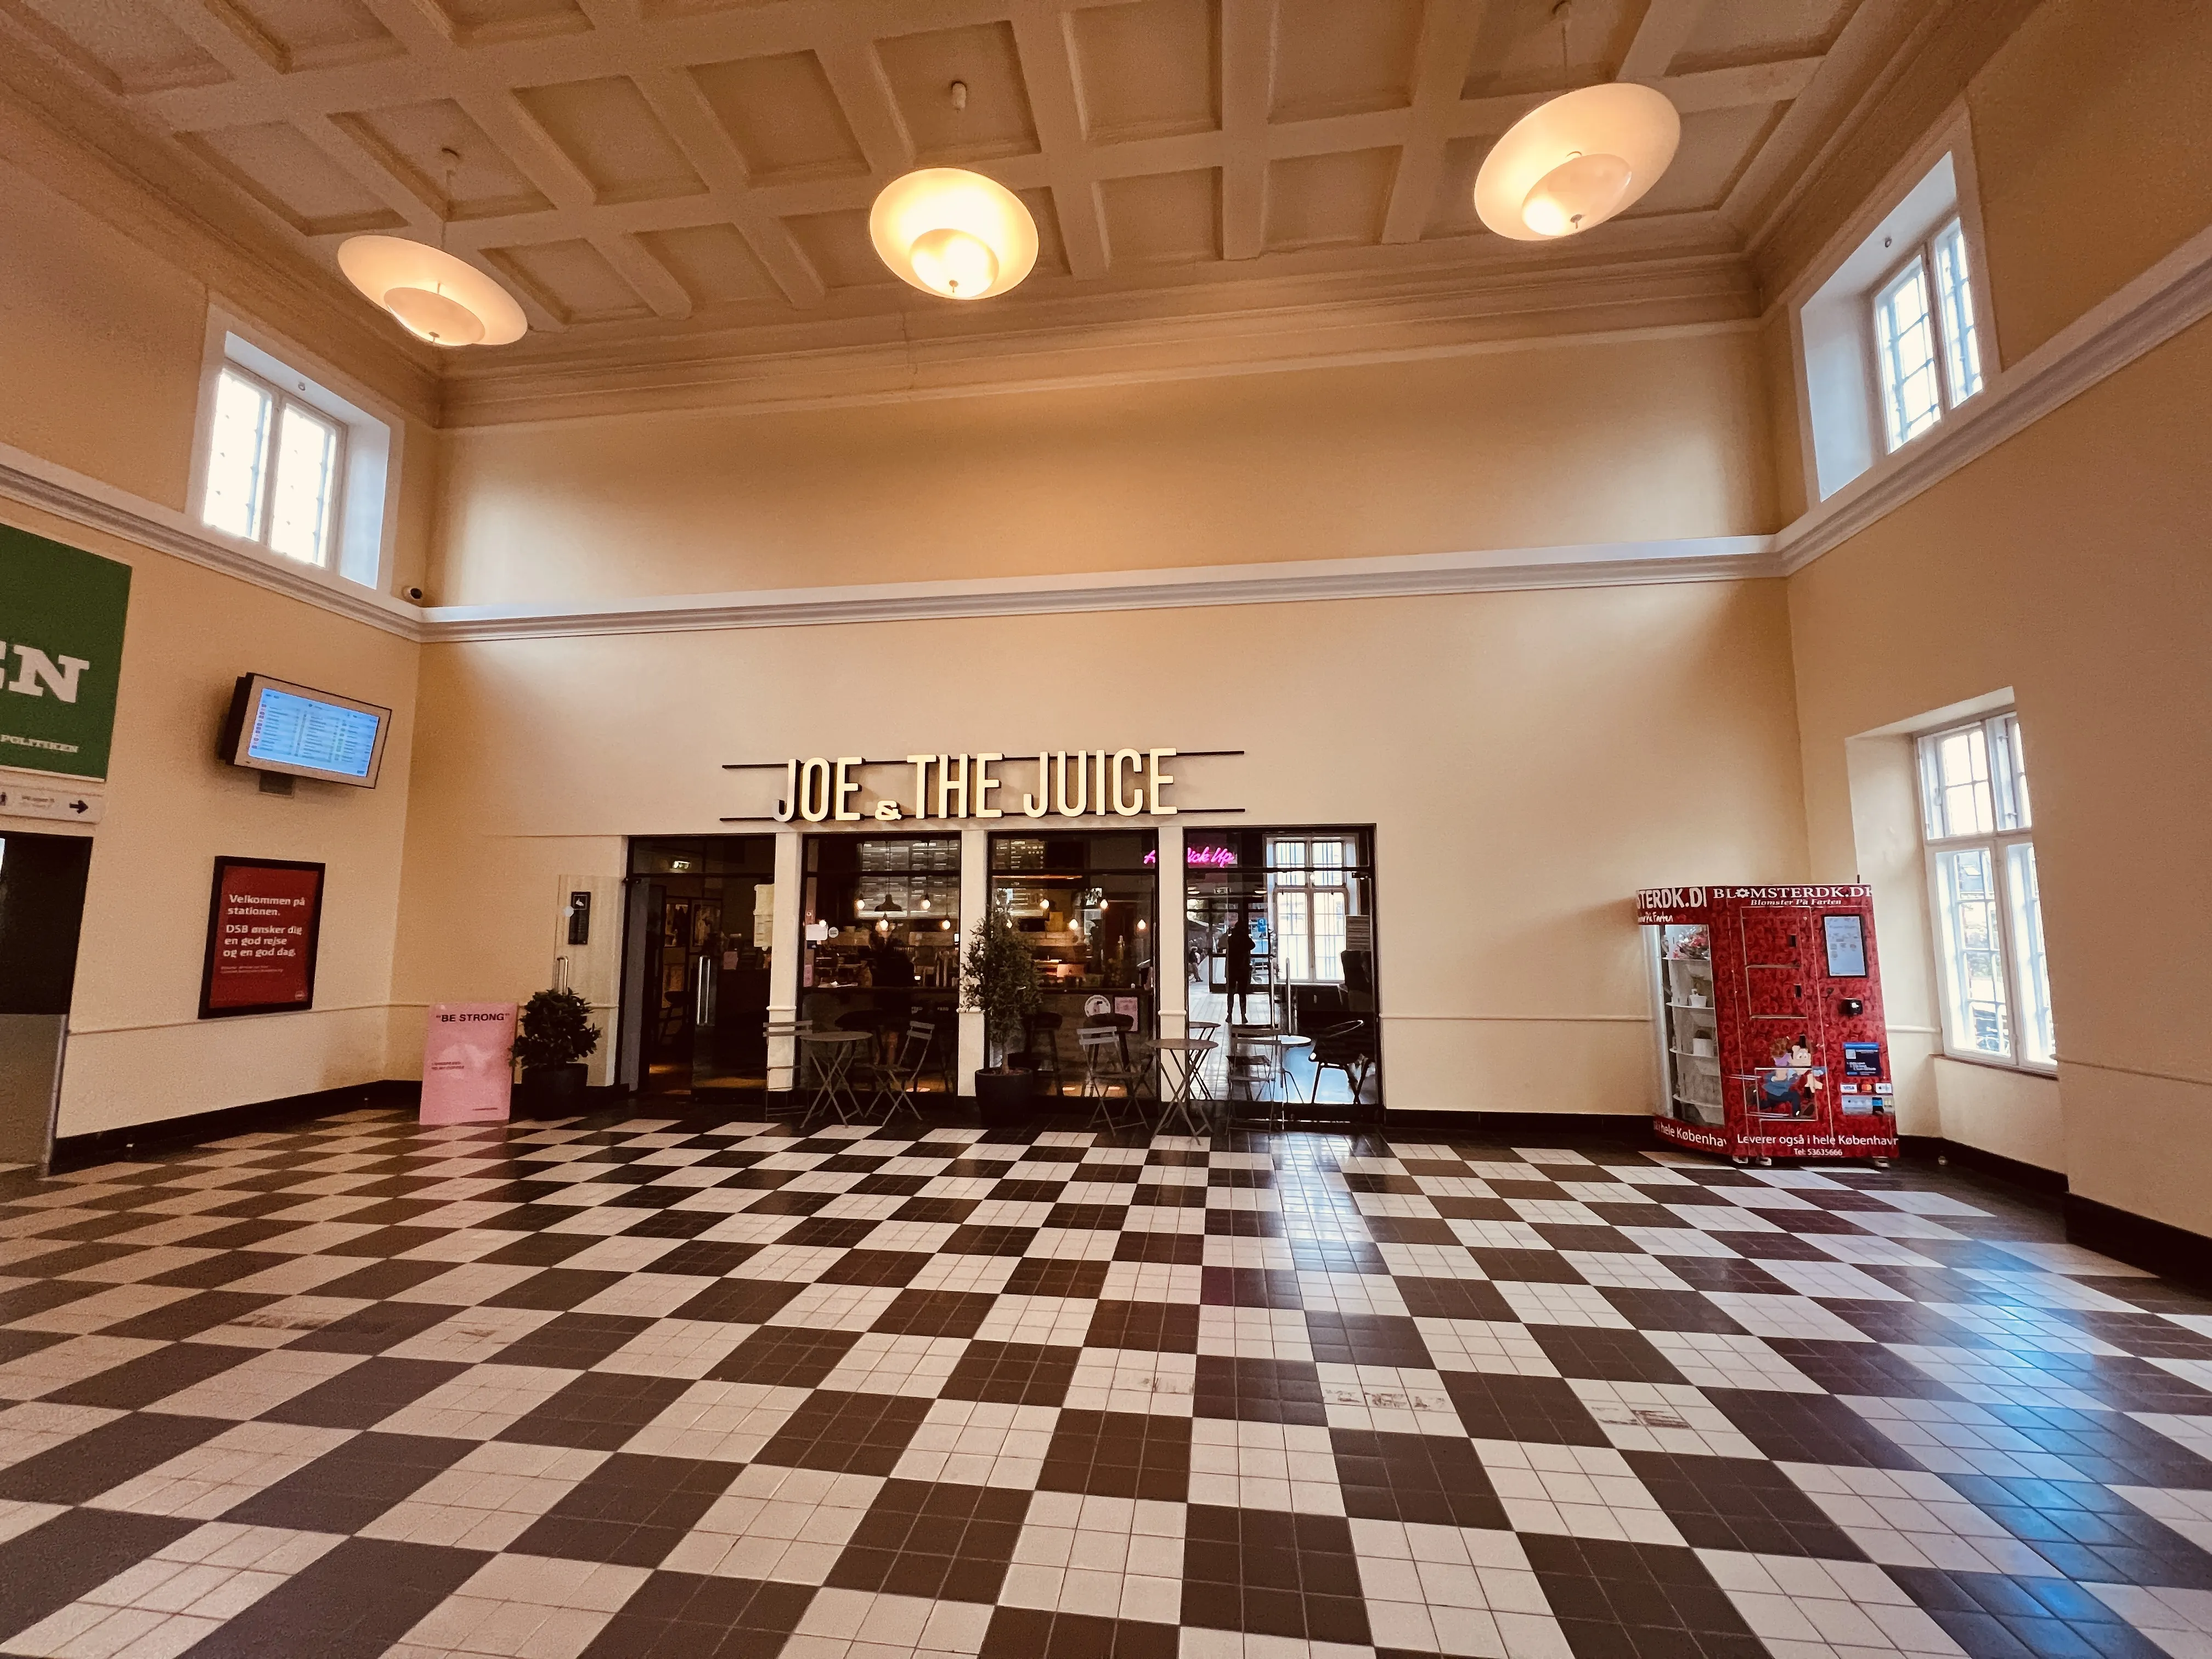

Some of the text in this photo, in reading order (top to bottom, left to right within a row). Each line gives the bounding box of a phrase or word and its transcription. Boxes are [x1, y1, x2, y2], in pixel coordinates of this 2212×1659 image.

[0, 640, 89, 703] N
[774, 748, 1178, 822] JOE & THE JUICE
[1210, 847, 1235, 868] Up
[229, 894, 305, 907] Velkommen på
[227, 906, 280, 916] stationen.
[226, 924, 303, 935] DSB ønsker dig
[241, 936, 261, 946] god
[263, 936, 287, 946] rejse
[223, 949, 238, 958] og
[255, 947, 275, 957] god
[276, 947, 296, 957] dag.
[436, 1013, 510, 1022] "BE STRONG"
[1737, 1135, 1776, 1144] Leverer
[1779, 1135, 1804, 1147] også
[1808, 1135, 1810, 1144] i
[1813, 1135, 1836, 1145] hele
